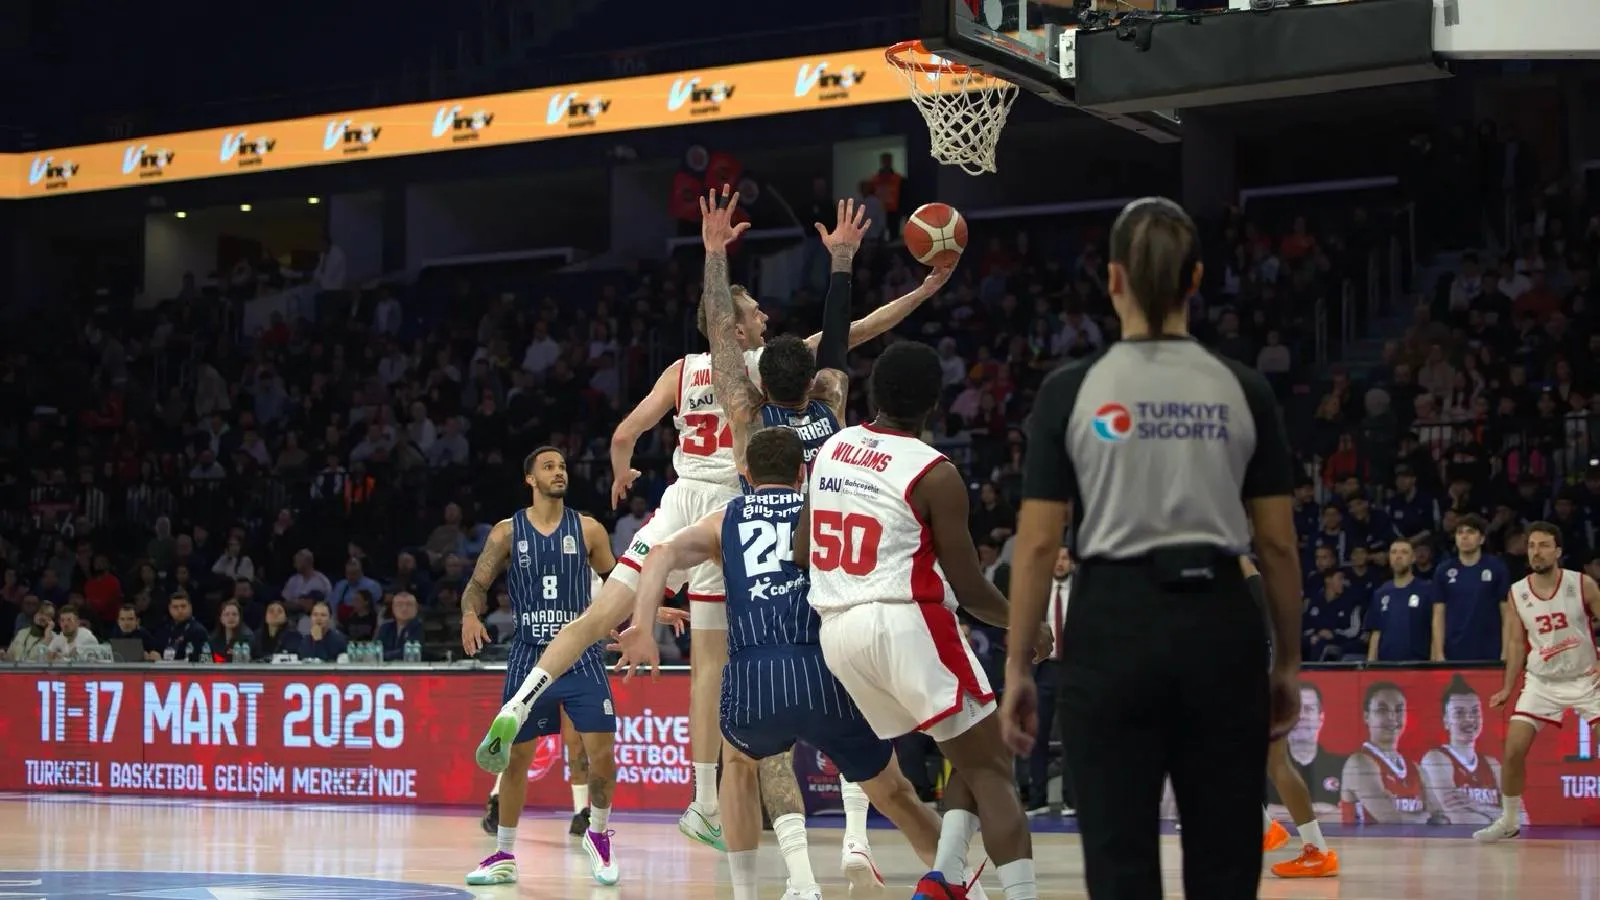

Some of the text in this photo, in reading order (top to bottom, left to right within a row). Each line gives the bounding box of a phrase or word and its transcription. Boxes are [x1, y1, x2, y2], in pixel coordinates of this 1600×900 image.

[831, 441, 892, 473] WILLIAMS
[819, 477, 842, 493] BAU
[812, 510, 883, 577] 50
[542, 575, 558, 600] 8
[532, 623, 567, 638] EFE
[1535, 612, 1568, 635] 33
[37, 681, 404, 749] 11-17 MART 2026
[25, 760, 417, 798] TURKCELL BASKETBOL GELİŞİM MERKEZİ'NDE
[1560, 775, 1600, 799] TUR
